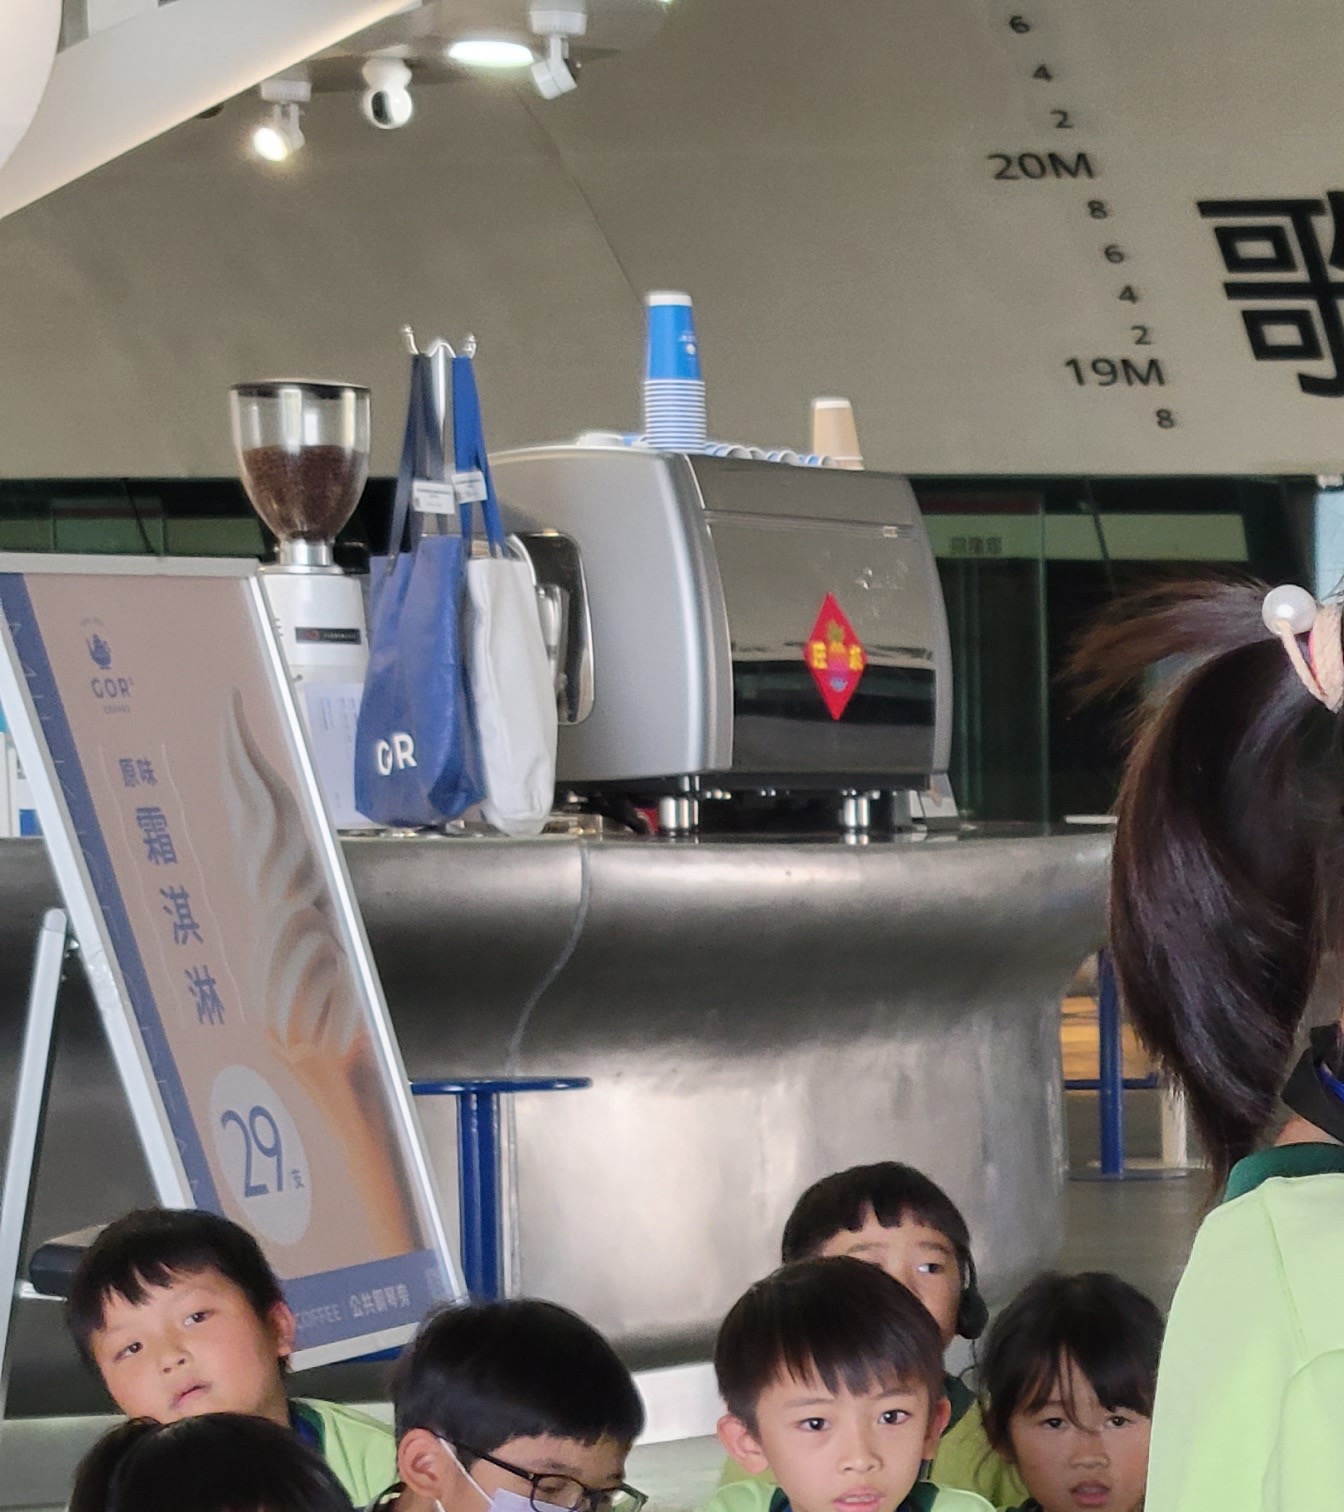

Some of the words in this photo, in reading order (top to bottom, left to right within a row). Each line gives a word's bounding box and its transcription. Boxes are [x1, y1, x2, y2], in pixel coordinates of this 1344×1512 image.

[1008, 15, 1031, 34] 6
[1032, 64, 1053, 82] 4
[1050, 110, 1074, 129] 2
[987, 152, 1095, 180] 20M
[1087, 200, 1108, 220] 8
[1104, 244, 1125, 264] 6
[1118, 285, 1139, 305] 4
[1130, 325, 1153, 346] 2
[1065, 357, 1166, 387] 19M
[1155, 408, 1175, 429] 8
[135, 806, 225, 1026] 霜淇淋
[220, 1105, 283, 1198] 29
